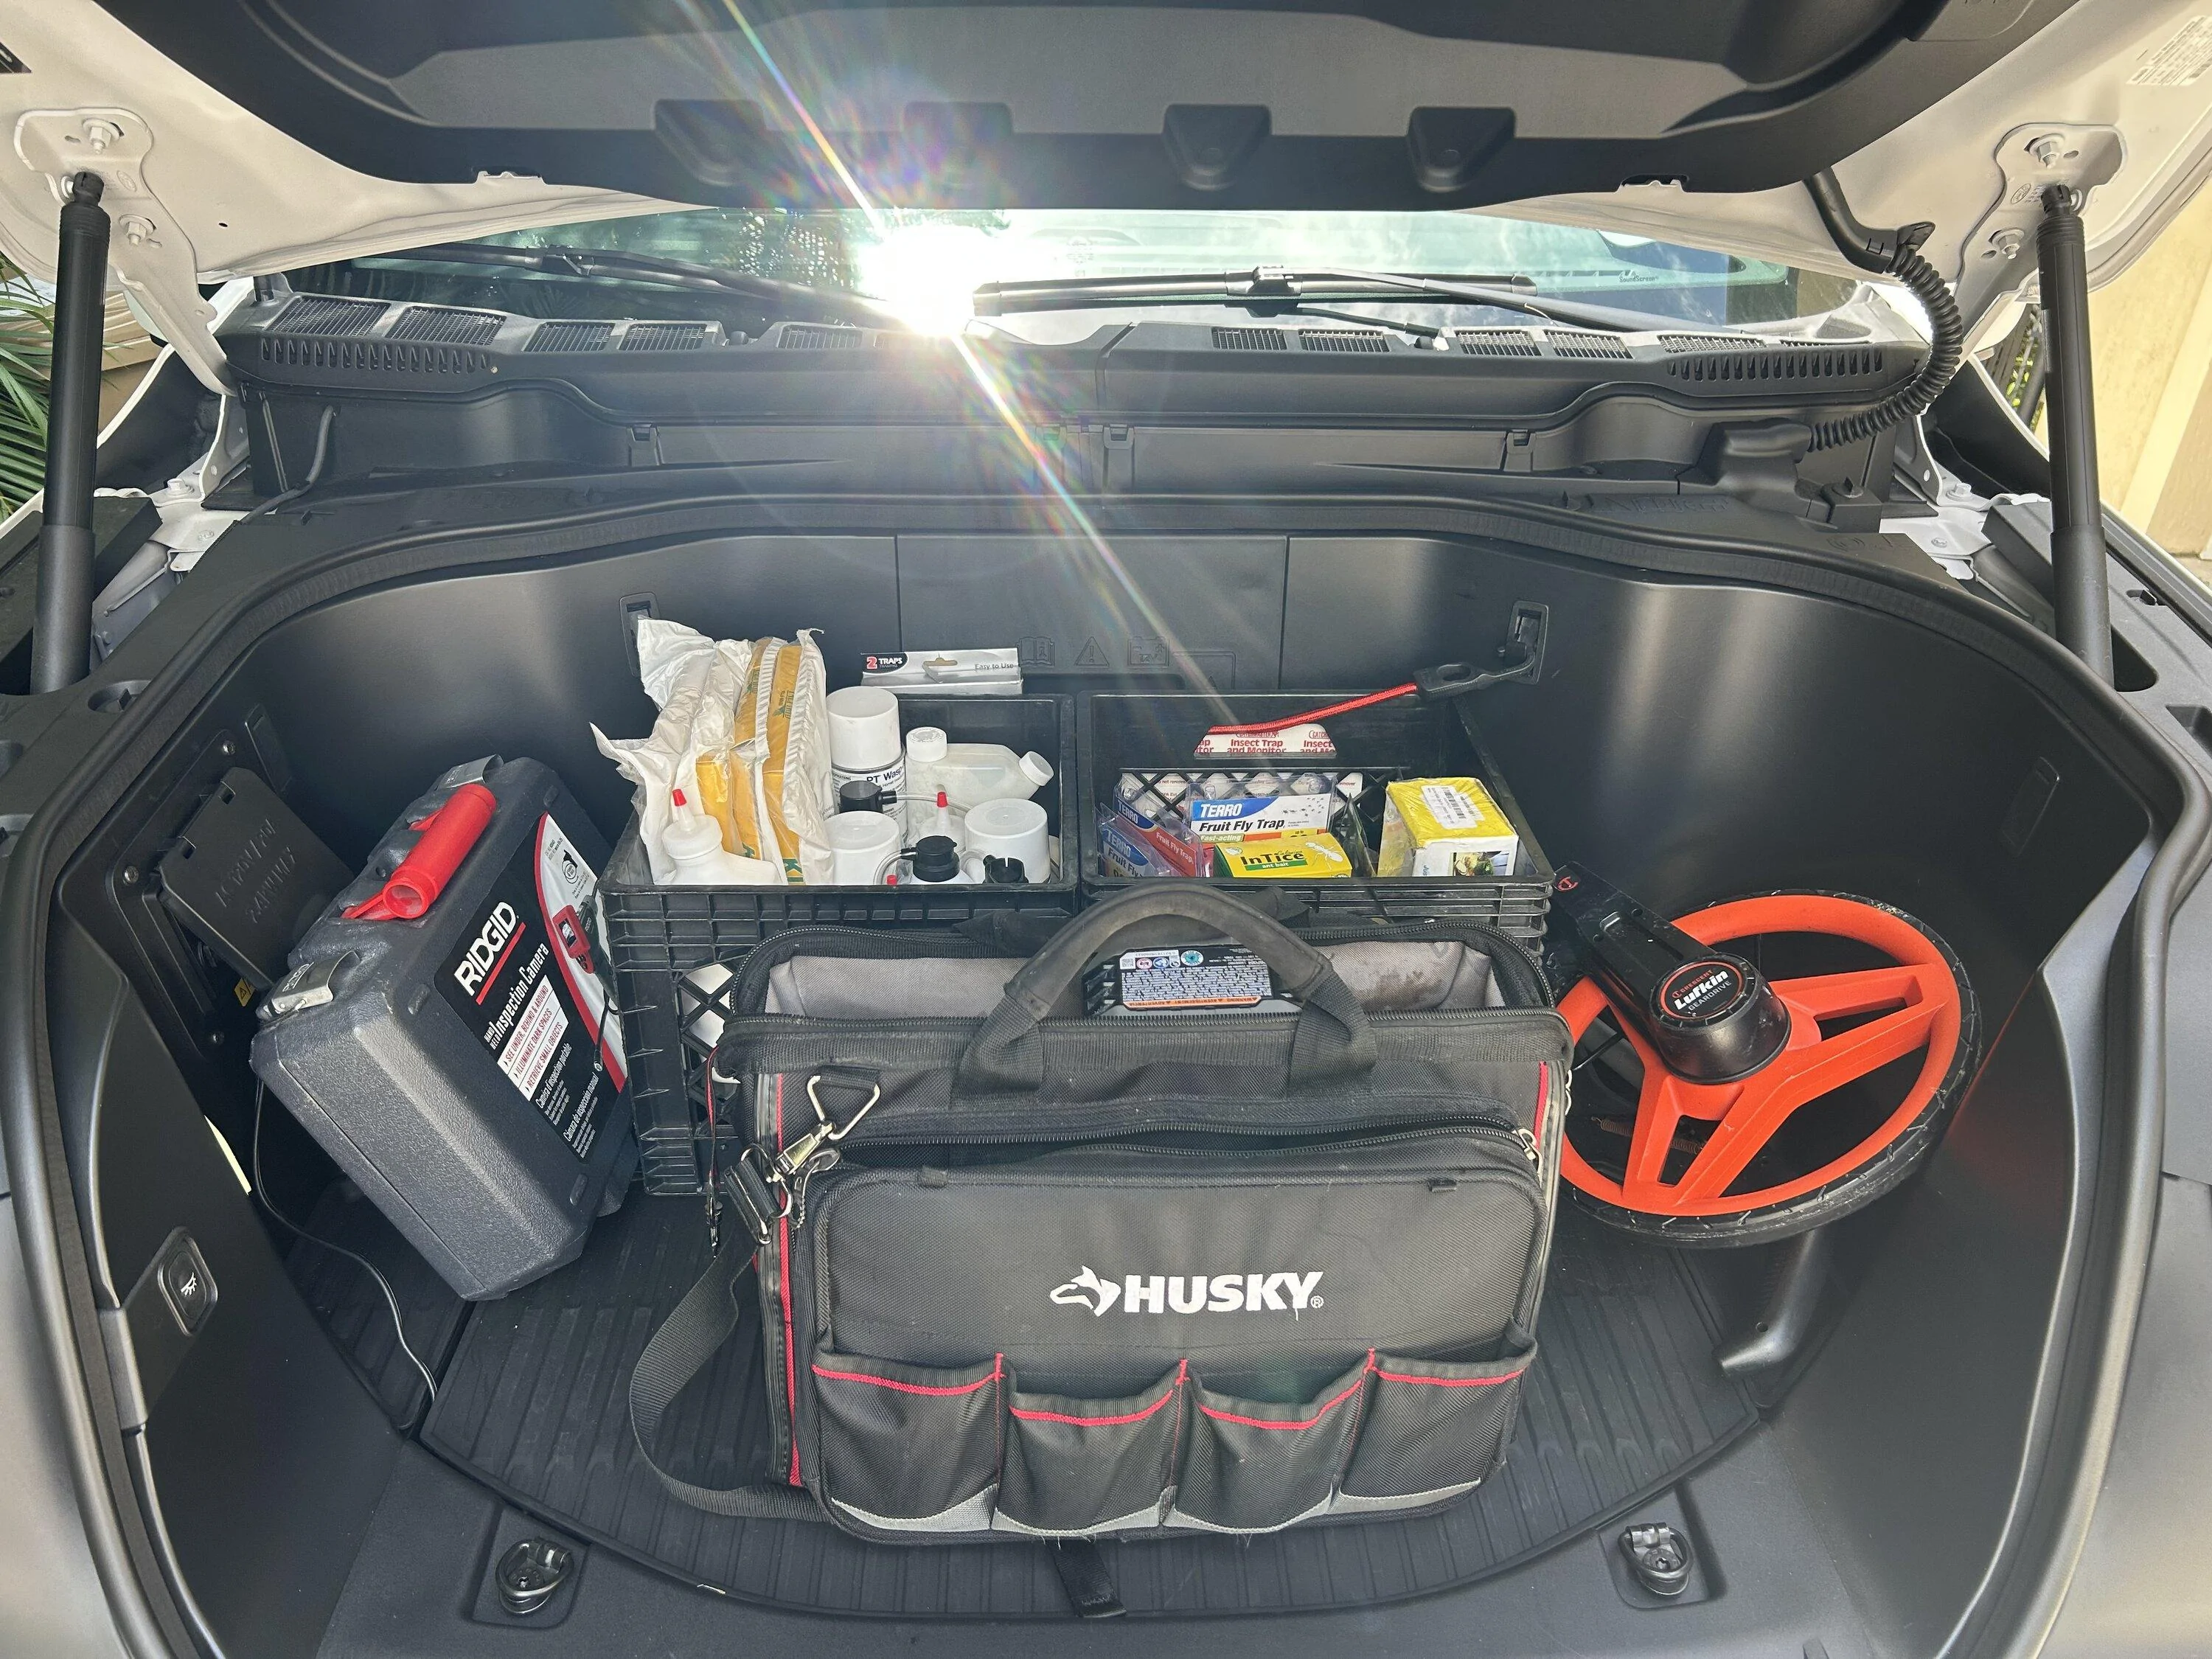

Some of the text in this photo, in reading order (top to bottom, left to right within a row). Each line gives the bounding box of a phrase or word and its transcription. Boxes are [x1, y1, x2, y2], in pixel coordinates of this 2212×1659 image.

[866, 656, 903, 669] 2 TRAPS
[975, 663, 990, 671] Easy
[1231, 739, 1283, 748] Insect Trap
[1117, 799, 1138, 824] TERRO
[1200, 802, 1242, 818] TERRO
[1199, 821, 1231, 832] Fruit
[1234, 820, 1253, 832] Fly
[1107, 829, 1131, 858] TERRO
[1156, 832, 1170, 847] Fruit
[1170, 844, 1179, 854] Fly
[1108, 847, 1127, 869] Fruit
[1240, 852, 1305, 865] InTice
[454, 902, 517, 996] RIDGID
[489, 943, 549, 1038] Inspection Camera
[1674, 970, 1728, 1010] Lufkin
[1680, 970, 1714, 993] CRESCENT
[1688, 980, 1732, 1011] GEARDRIVE
[484, 1025, 495, 1043] HAND
[505, 1047, 515, 1062] SEE
[521, 1011, 535, 1033] BEHIND
[536, 985, 549, 1007] AROUND
[490, 1033, 501, 1051] HELD
[516, 1008, 553, 1076] ILLUMINATE DARK SPACES
[527, 1022, 563, 1089] RETRIEVE SMALL OBJECTS
[558, 1043, 572, 1067] portable
[587, 1071, 599, 1101] manual
[1124, 1271, 1324, 1314] HUSKY
